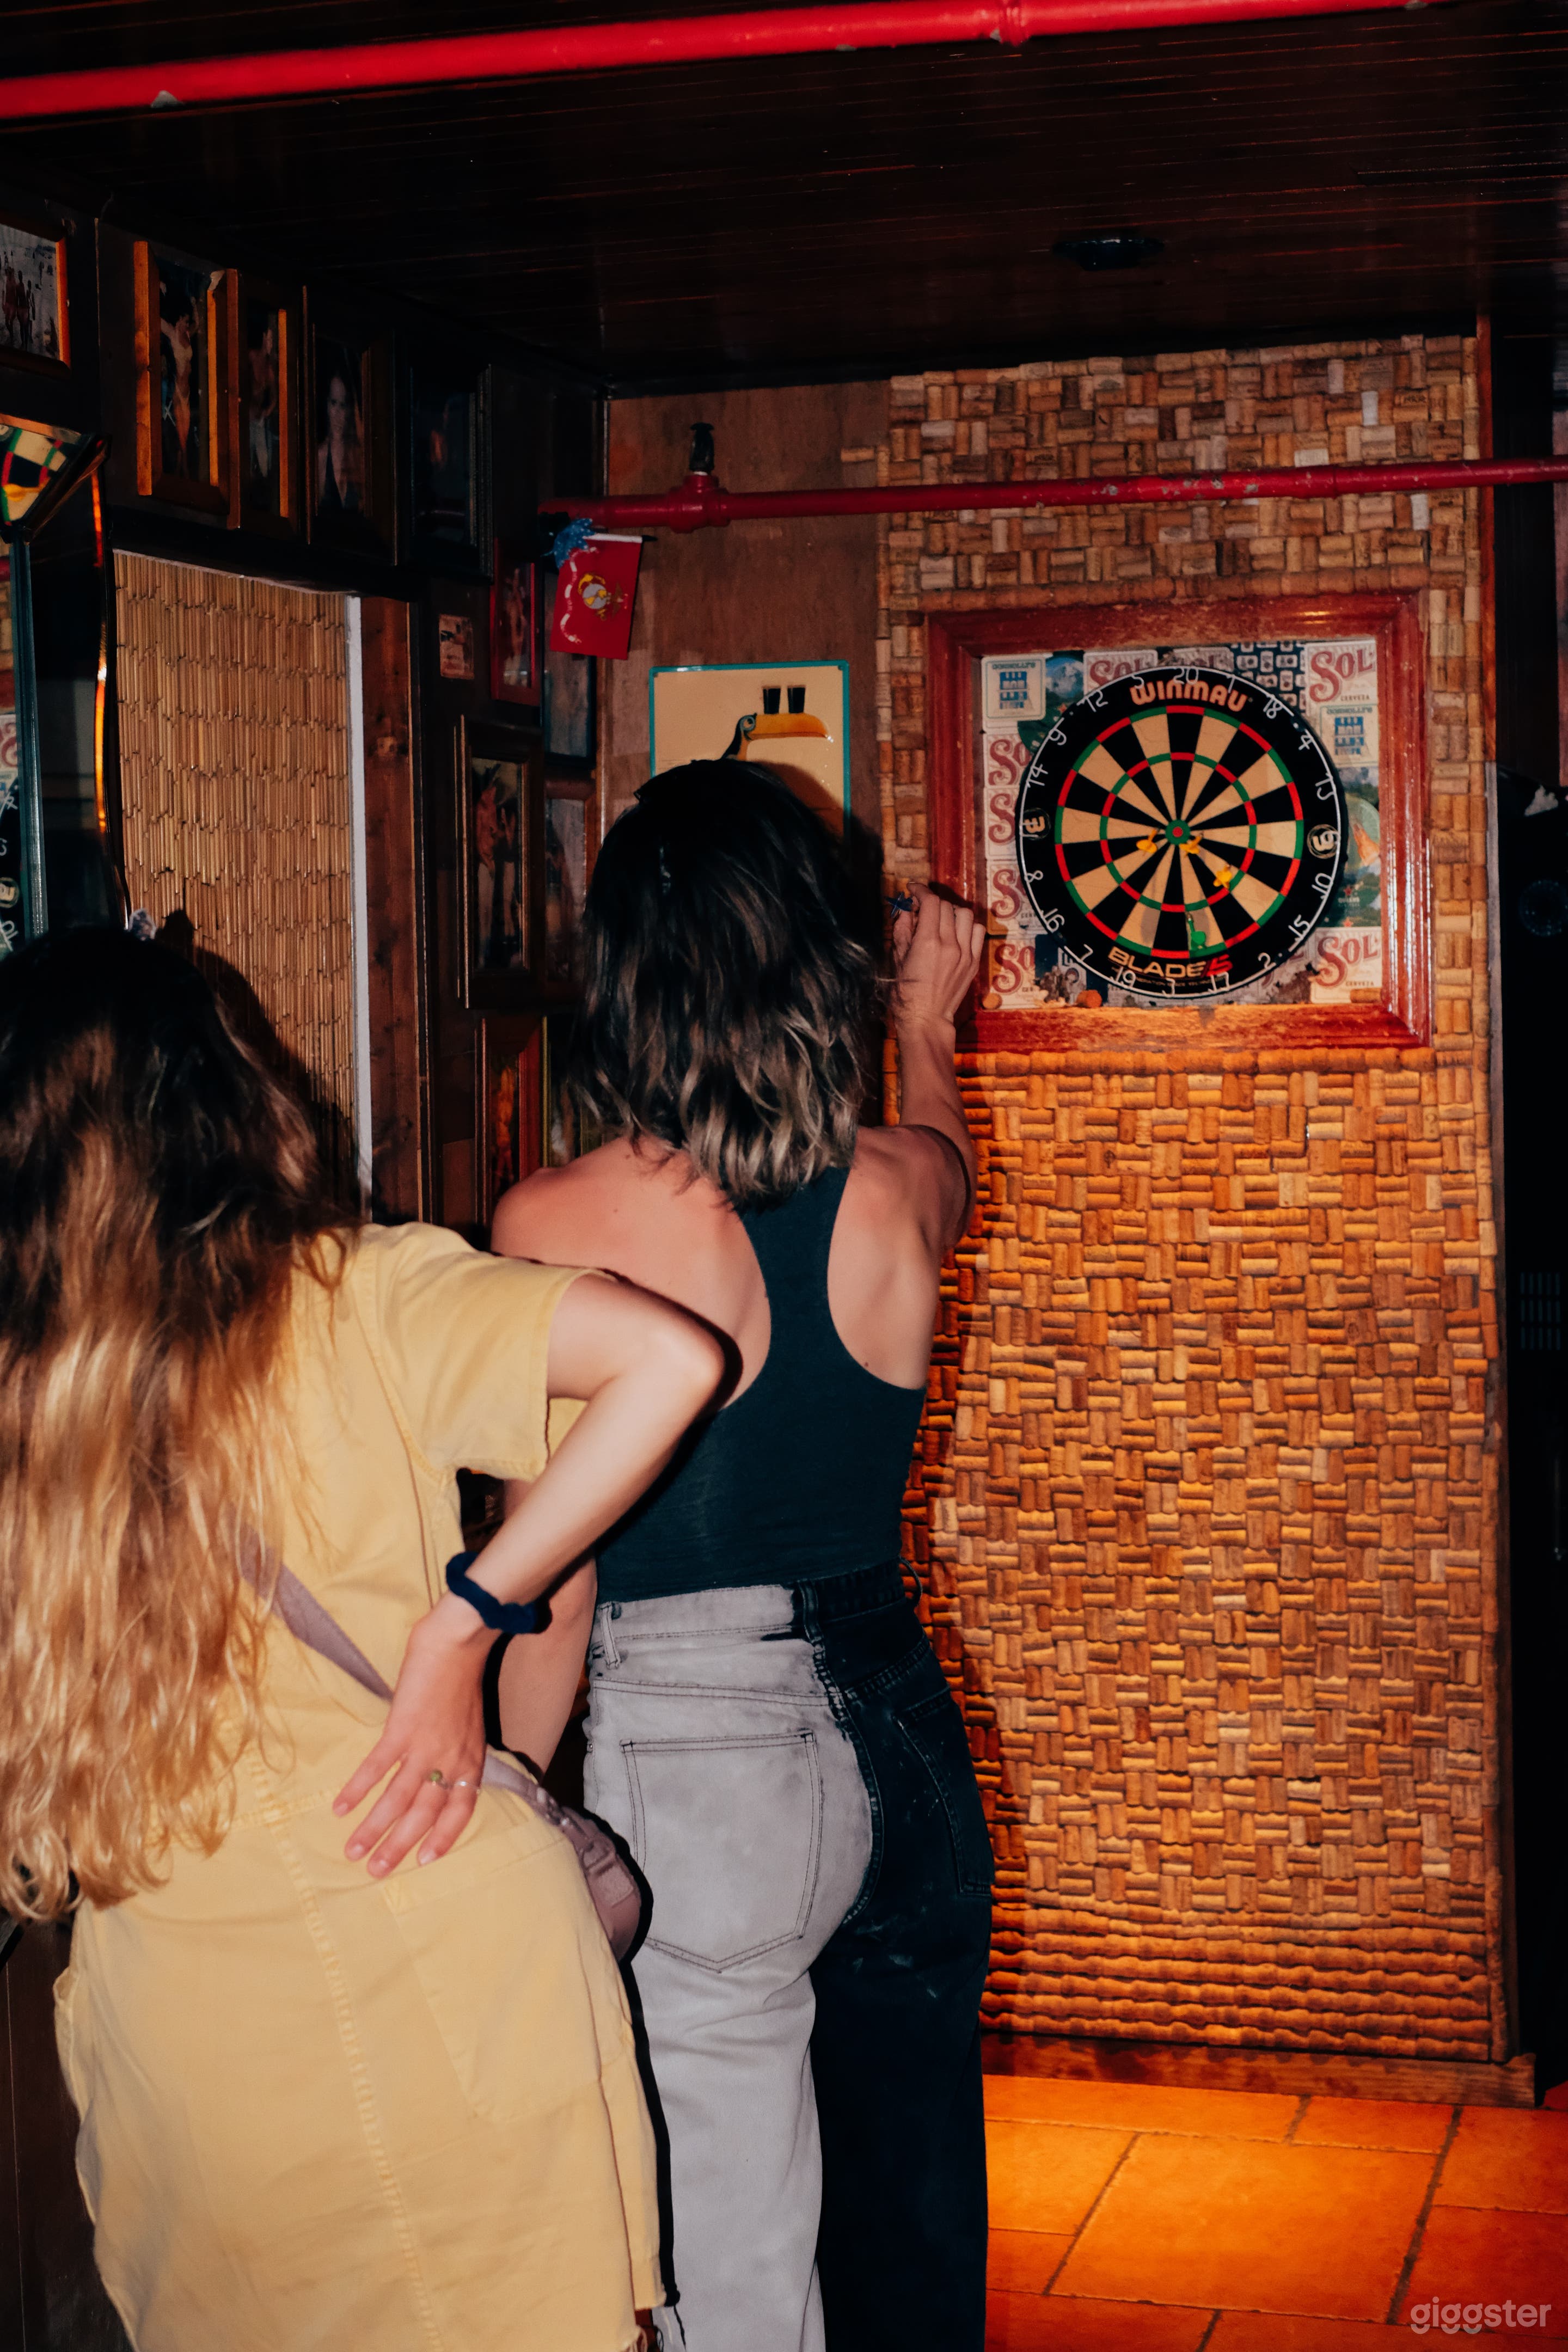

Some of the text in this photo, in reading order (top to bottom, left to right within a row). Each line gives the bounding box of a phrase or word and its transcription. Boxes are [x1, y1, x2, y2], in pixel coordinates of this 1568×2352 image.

[1173, 666, 1199, 685] 20
[1309, 649, 1374, 702] SOL
[1076, 689, 1108, 713] 12
[1129, 681, 1248, 712] WINMAU
[1263, 695, 1283, 719] 18
[1050, 727, 1067, 746] 9
[1298, 735, 1314, 751] 4
[1027, 763, 1049, 787] 14
[1024, 870, 1044, 883] 8
[1311, 872, 1334, 899] 10
[1043, 908, 1065, 933] 16
[1288, 914, 1310, 942] 15
[1079, 944, 1094, 963] 7
[1258, 952, 1276, 970] 2
[1315, 936, 1378, 987] SOL
[1109, 965, 1136, 989] 19
[1161, 977, 1176, 996] 3
[1208, 971, 1229, 993] 17
